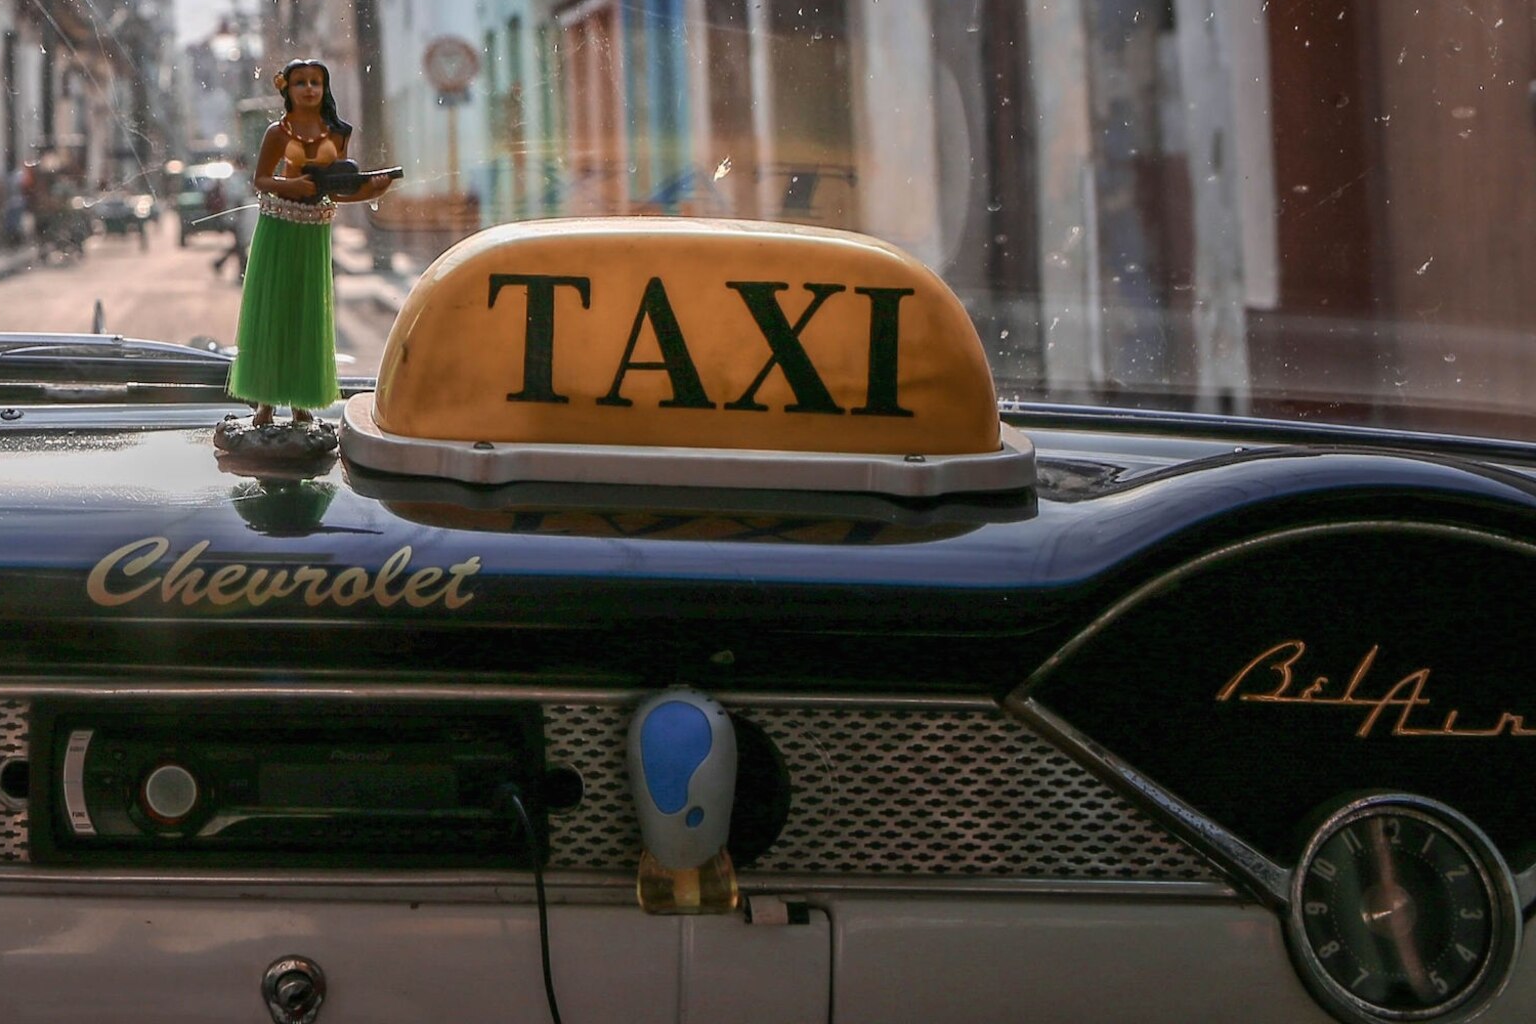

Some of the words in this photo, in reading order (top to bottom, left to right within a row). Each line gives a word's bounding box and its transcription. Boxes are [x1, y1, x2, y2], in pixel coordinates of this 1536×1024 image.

[487, 273, 915, 418] TAXI
[86, 536, 482, 610] Chevrolet
[1216, 639, 1384, 703] Bel
[1355, 667, 1536, 738] Air
[1422, 832, 1435, 854] 1
[1310, 857, 1336, 882] 10
[1445, 865, 1469, 882] 2
[1460, 908, 1484, 920] 3
[1319, 940, 1340, 959] 8
[1455, 943, 1477, 962] 4
[1429, 971, 1448, 994] 5
